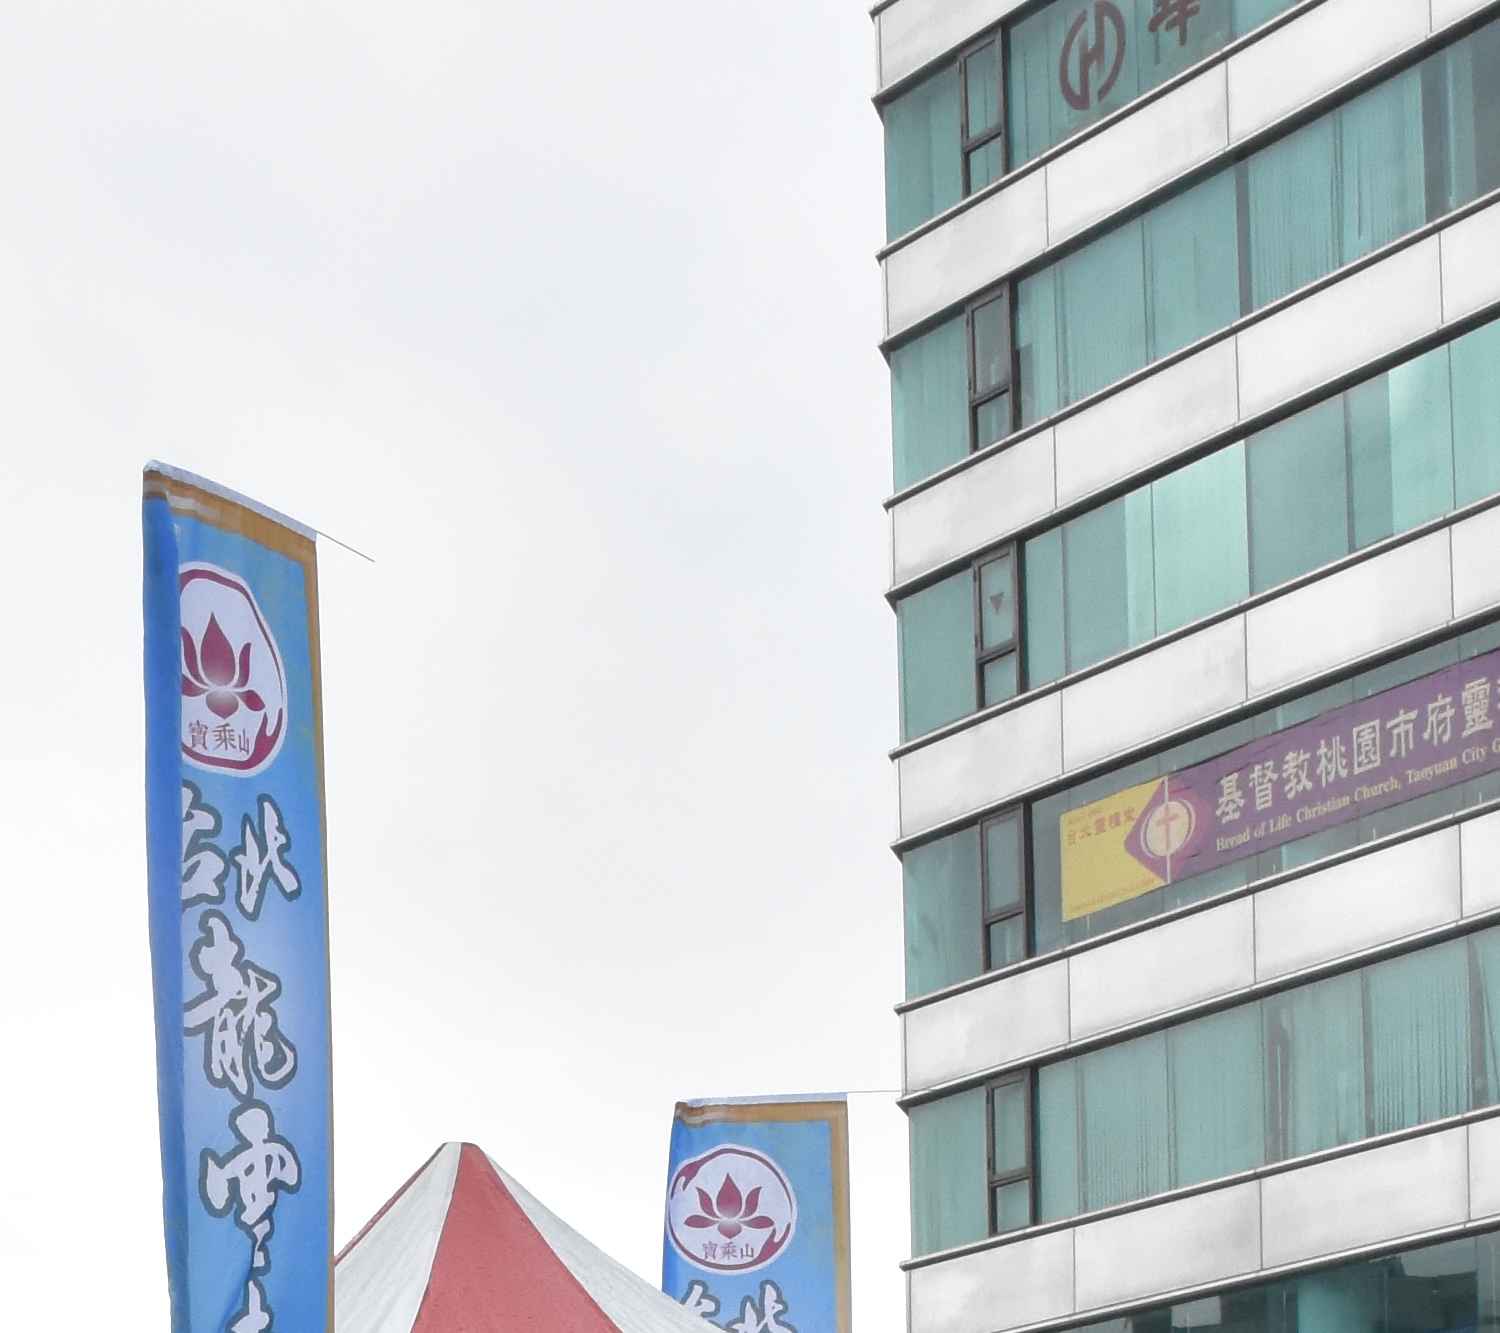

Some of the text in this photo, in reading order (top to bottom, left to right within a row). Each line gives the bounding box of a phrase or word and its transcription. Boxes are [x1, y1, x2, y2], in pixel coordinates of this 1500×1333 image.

[1216, 826, 1250, 852] Bread
[1254, 822, 1267, 838] of
[1270, 813, 1292, 834] Life
[1296, 794, 1350, 823] Christian
[1405, 756, 1458, 784] Taoyuan
[1462, 745, 1488, 765] City
